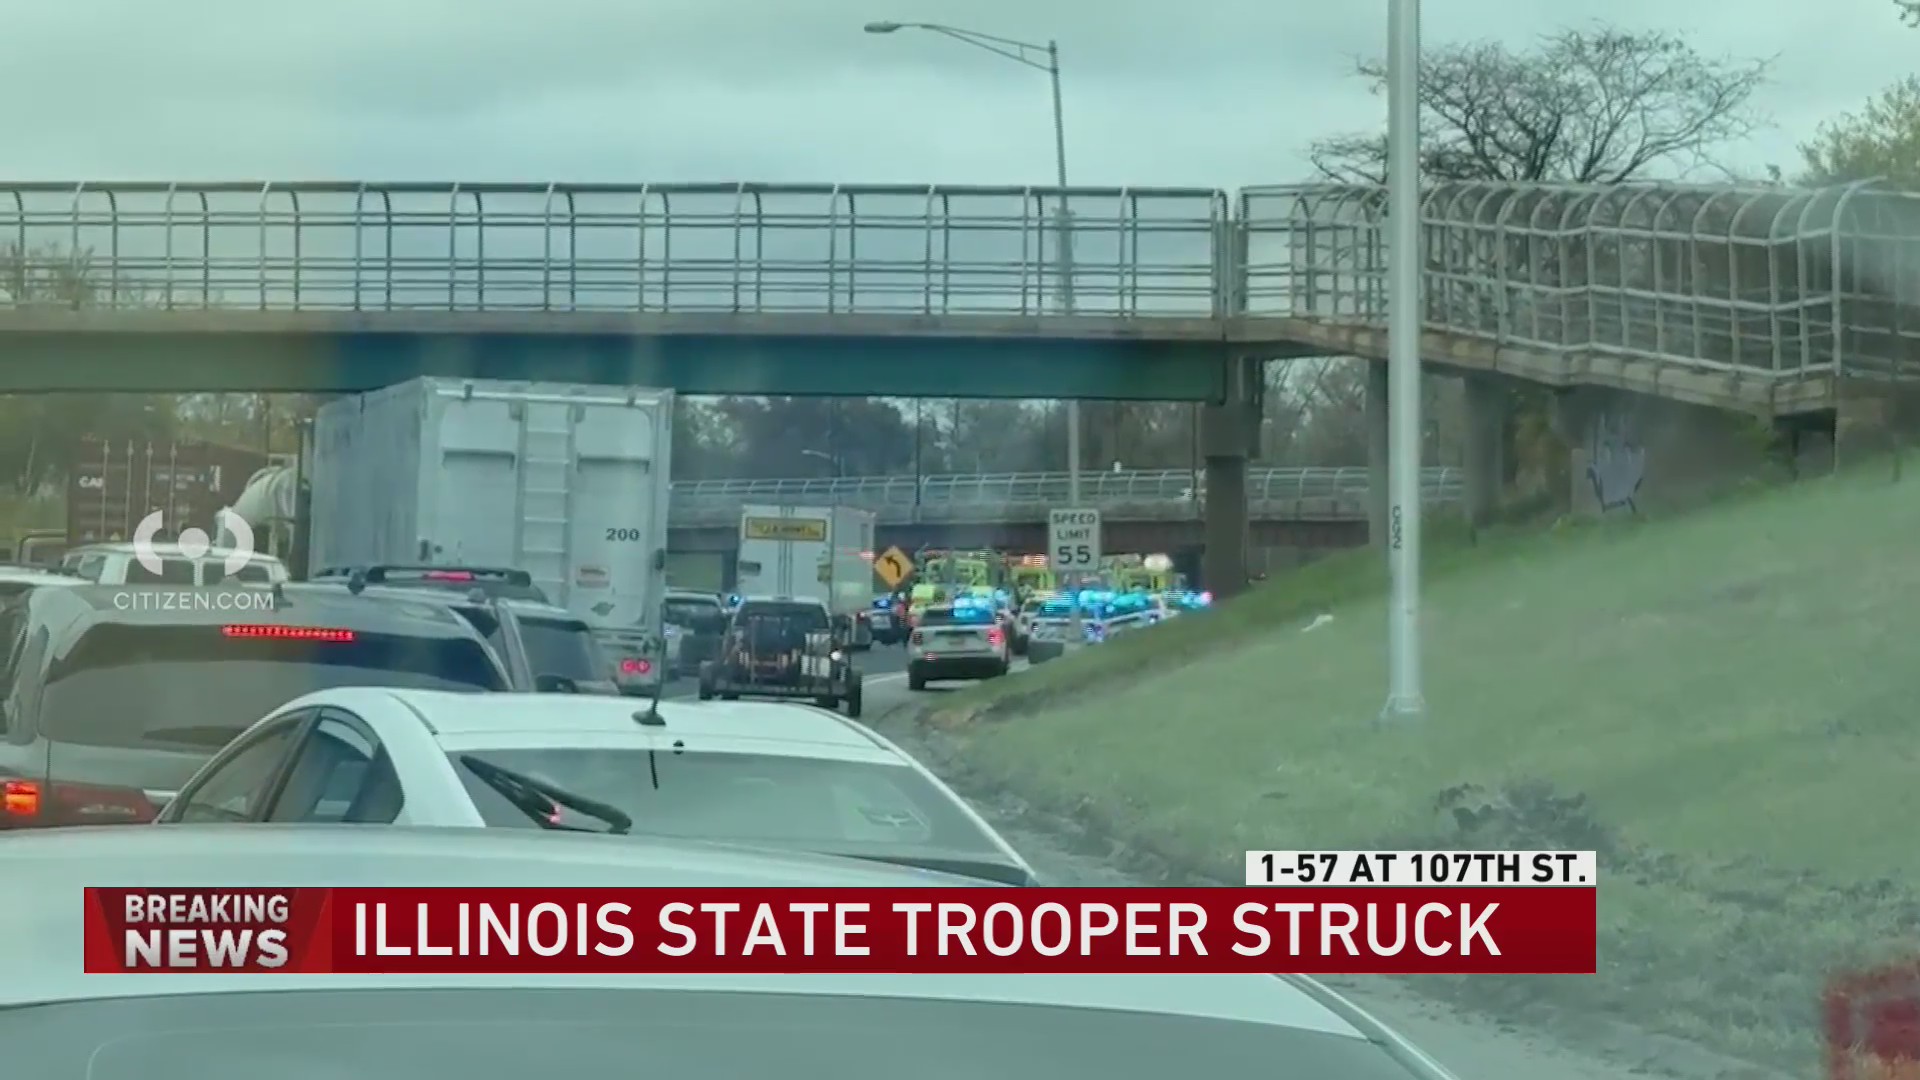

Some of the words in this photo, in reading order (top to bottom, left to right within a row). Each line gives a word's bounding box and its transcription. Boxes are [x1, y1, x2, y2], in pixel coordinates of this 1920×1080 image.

[1053, 512, 1096, 524] SPEED
[606, 527, 640, 541] 200
[1056, 529, 1090, 540] LIMIT
[1058, 545, 1091, 564] 55
